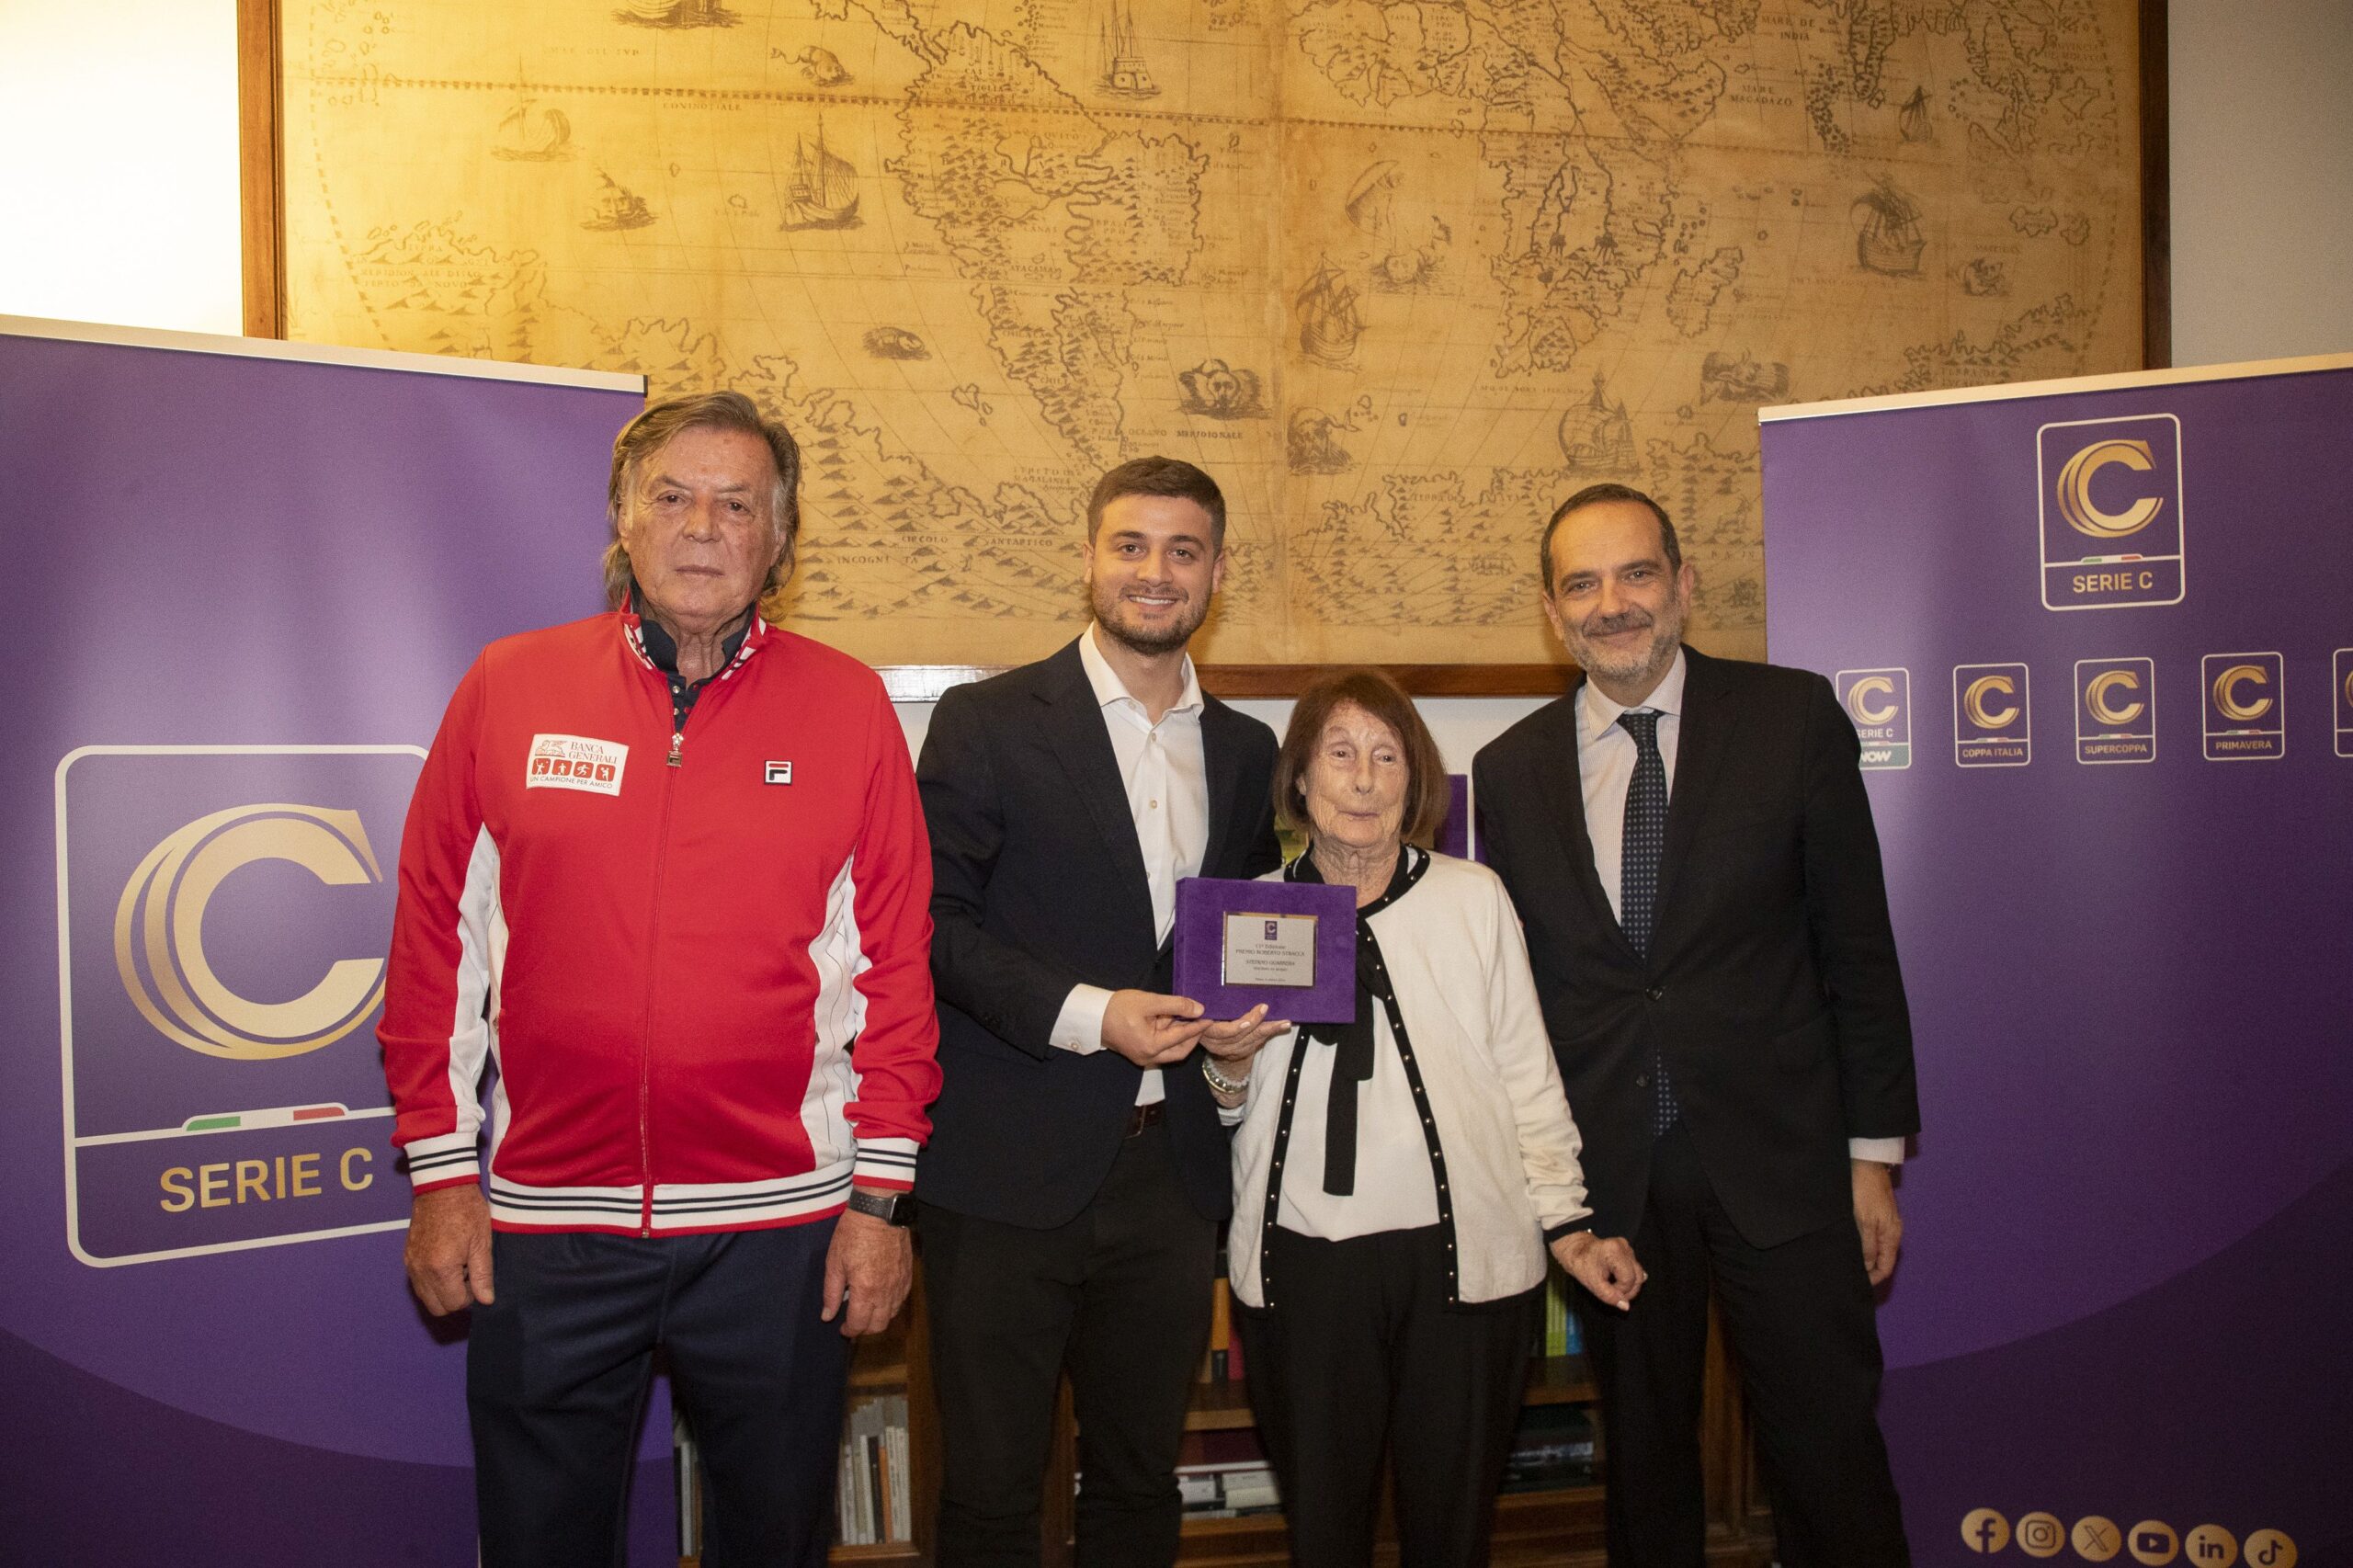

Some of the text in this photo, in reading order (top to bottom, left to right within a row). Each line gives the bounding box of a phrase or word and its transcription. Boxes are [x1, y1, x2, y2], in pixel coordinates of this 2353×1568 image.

[2073, 571, 2153, 593] SERIE C
[1886, 728, 1893, 738] C
[570, 741, 604, 754] BANCA
[2085, 744, 2147, 756] SUPERCOPPA
[2215, 740, 2272, 751] PRIMAVERA
[569, 751, 618, 765] GENERALI
[1962, 747, 2023, 758] COPPA ITALIA
[540, 776, 576, 784] CAMPIONE
[160, 1147, 373, 1212] SERIE C
